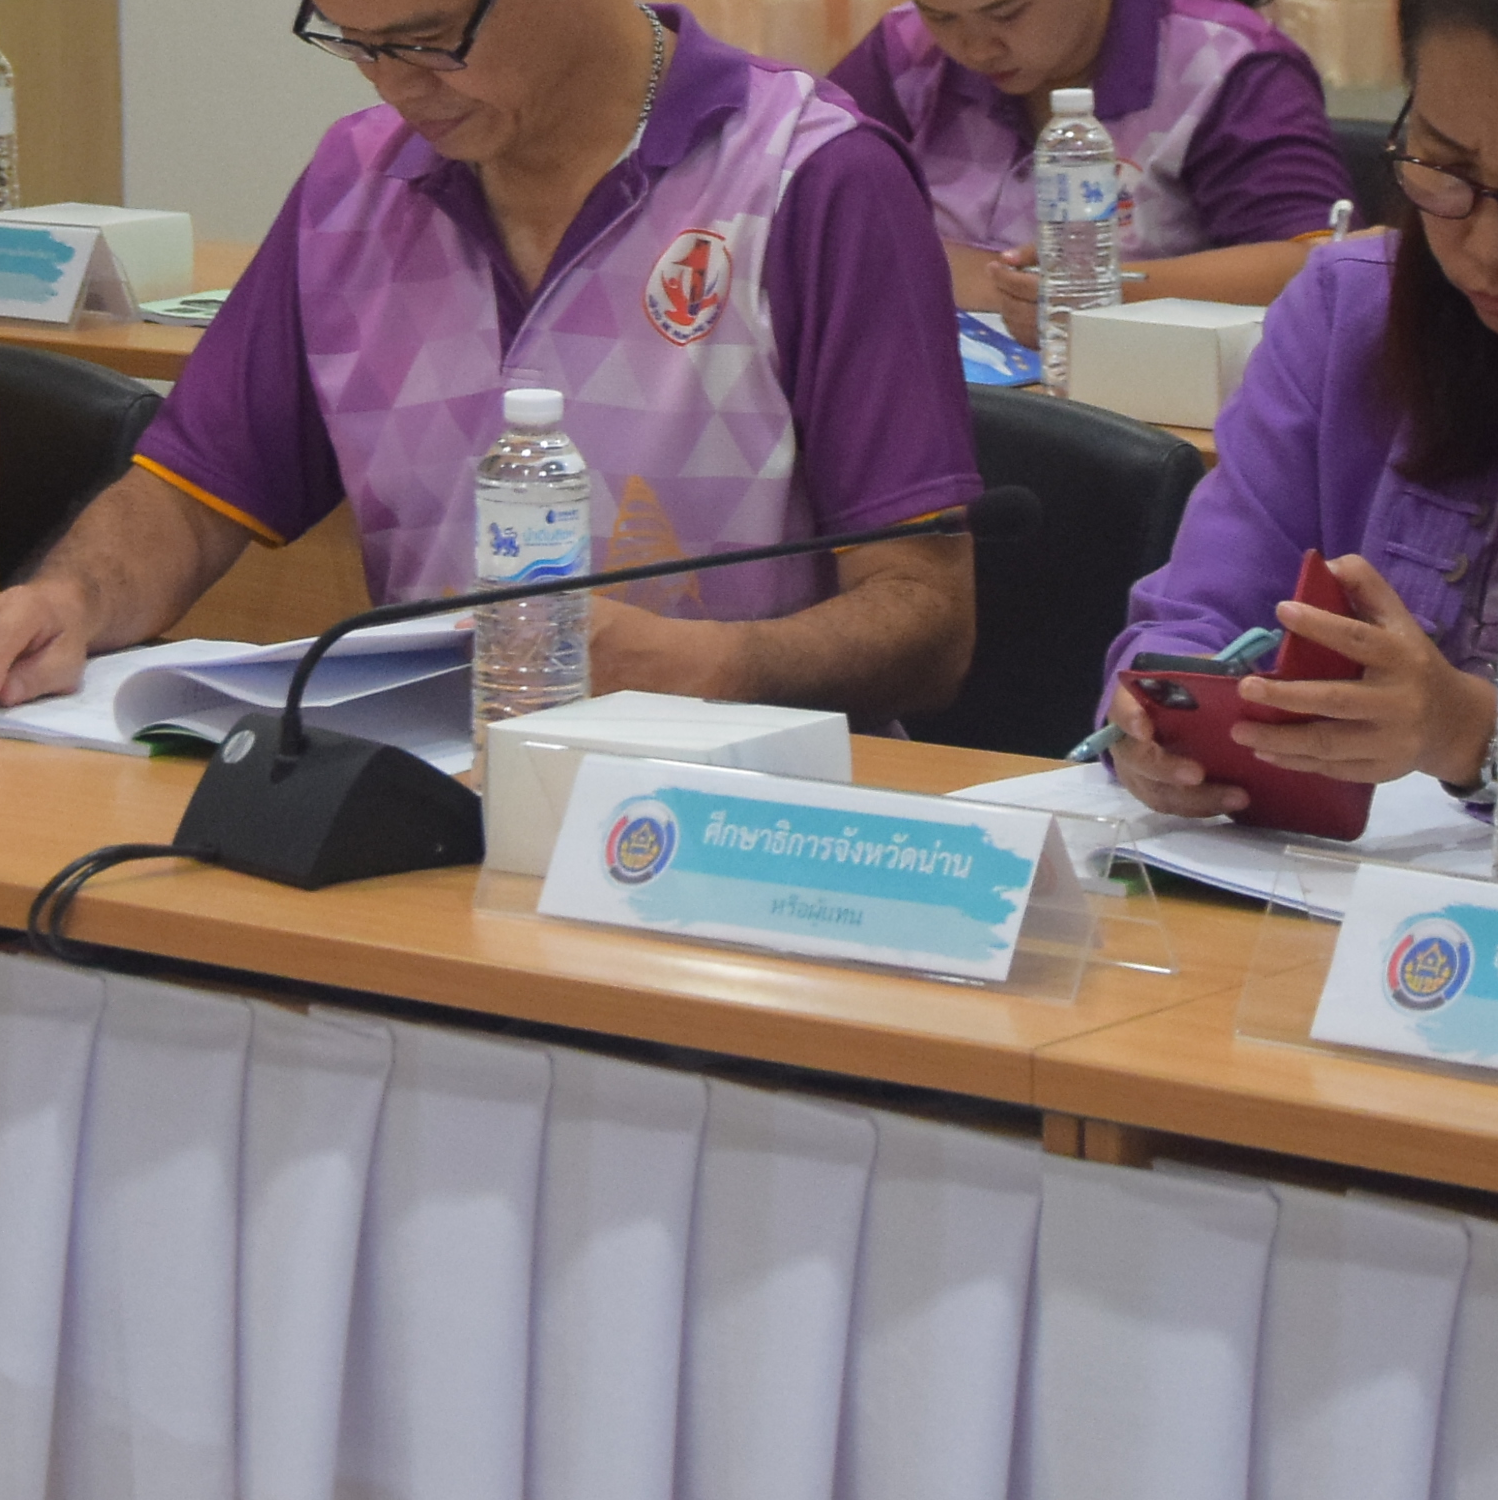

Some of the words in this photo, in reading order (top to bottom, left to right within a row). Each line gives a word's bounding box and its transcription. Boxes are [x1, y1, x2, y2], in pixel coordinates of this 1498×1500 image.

[703, 810, 974, 880] ศึกษาธิการจังหวัดน่าน
[769, 893, 865, 928] หรือผู้แทน
